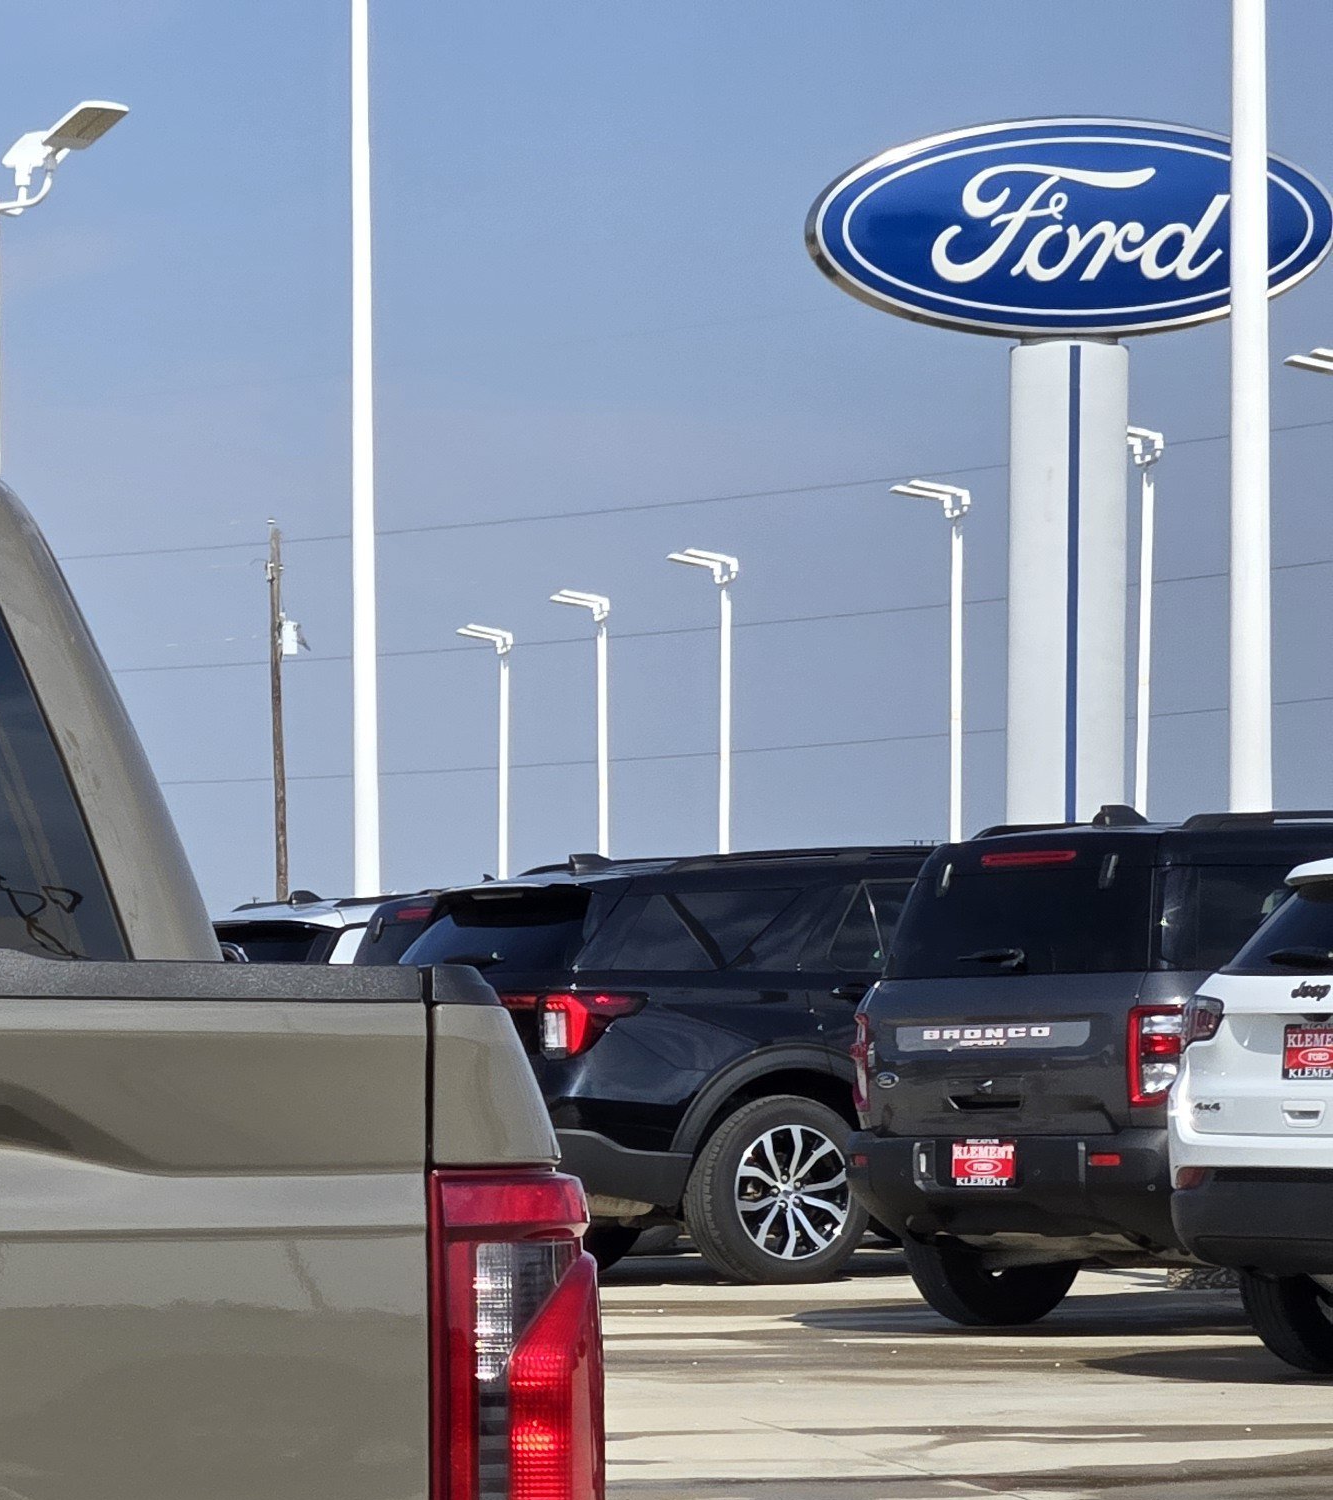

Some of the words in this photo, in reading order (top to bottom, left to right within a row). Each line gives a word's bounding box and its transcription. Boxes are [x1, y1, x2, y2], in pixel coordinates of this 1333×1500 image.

[932, 163, 1231, 282] Ford
[923, 1027, 1050, 1040] BRONCO
[959, 1039, 1007, 1047] SPORT
[1289, 1068, 1333, 1078] KLEME
[953, 1145, 1015, 1159] KLEMENT
[956, 1177, 1009, 1186] KLEMENT
